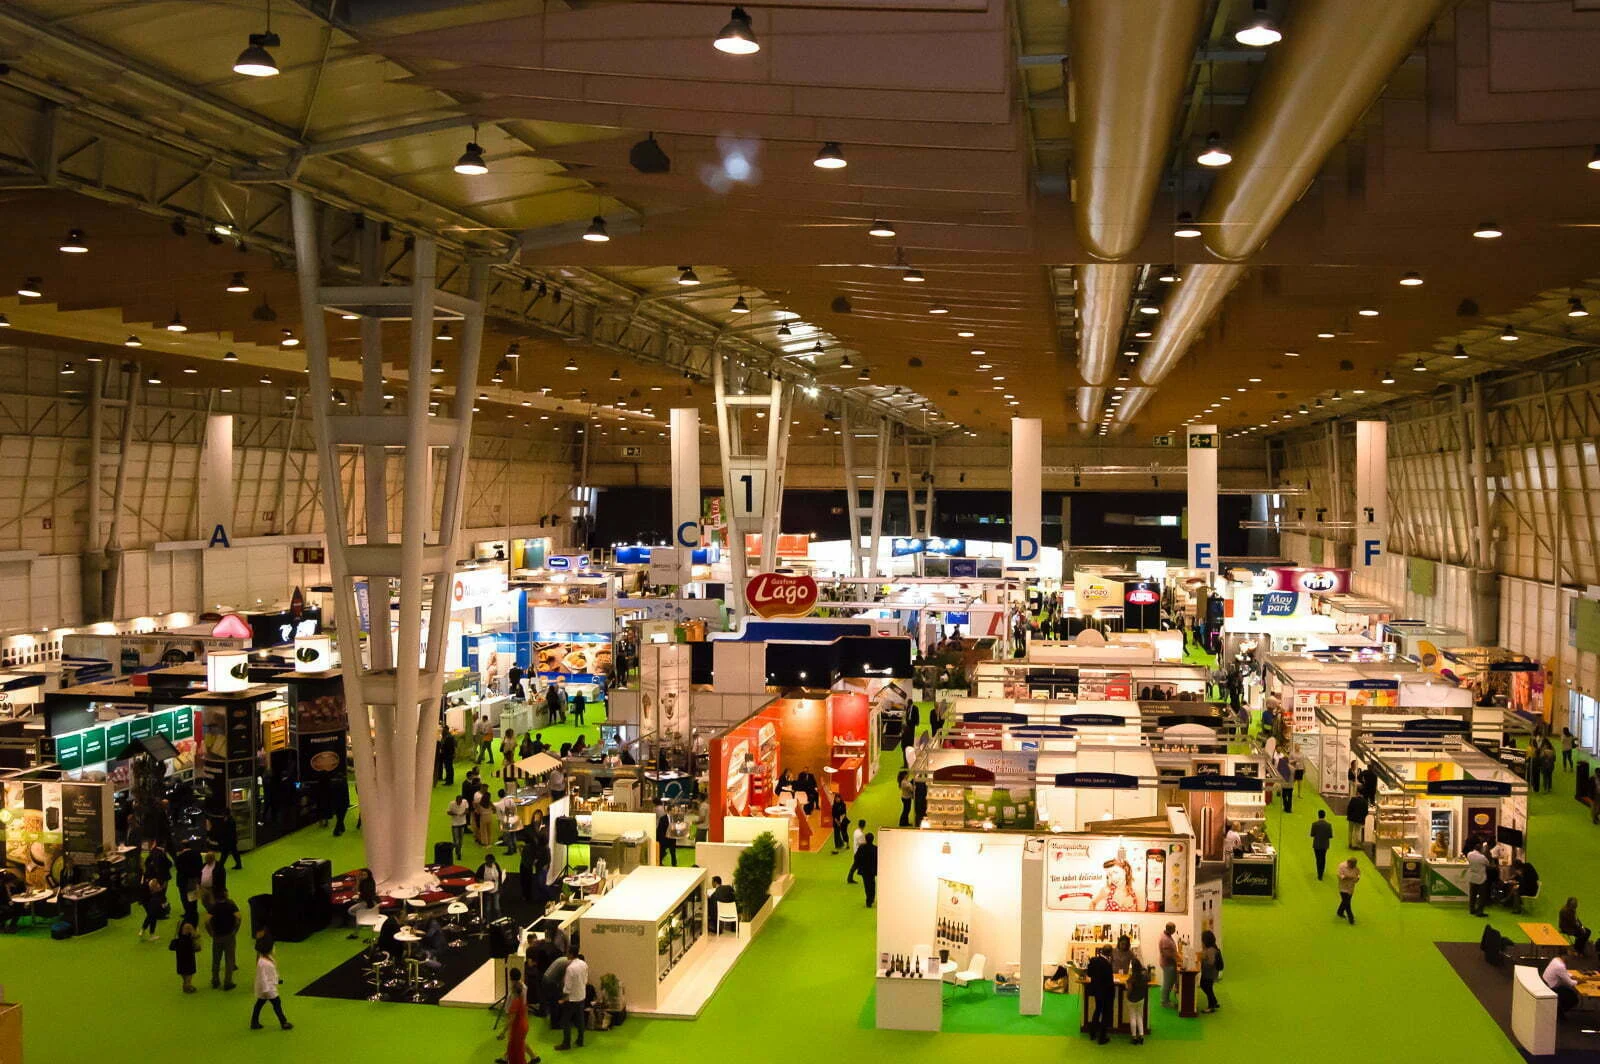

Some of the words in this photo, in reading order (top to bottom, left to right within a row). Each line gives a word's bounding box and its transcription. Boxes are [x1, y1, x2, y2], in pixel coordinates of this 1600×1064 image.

[740, 475, 752, 512] 1
[209, 524, 230, 548] A
[677, 521, 698, 548] C
[1015, 535, 1038, 561] D
[1195, 543, 1211, 568] E
[1365, 540, 1381, 565] F
[755, 577, 808, 604] Lago
[1269, 594, 1293, 605] Moy
[1267, 604, 1291, 613] park
